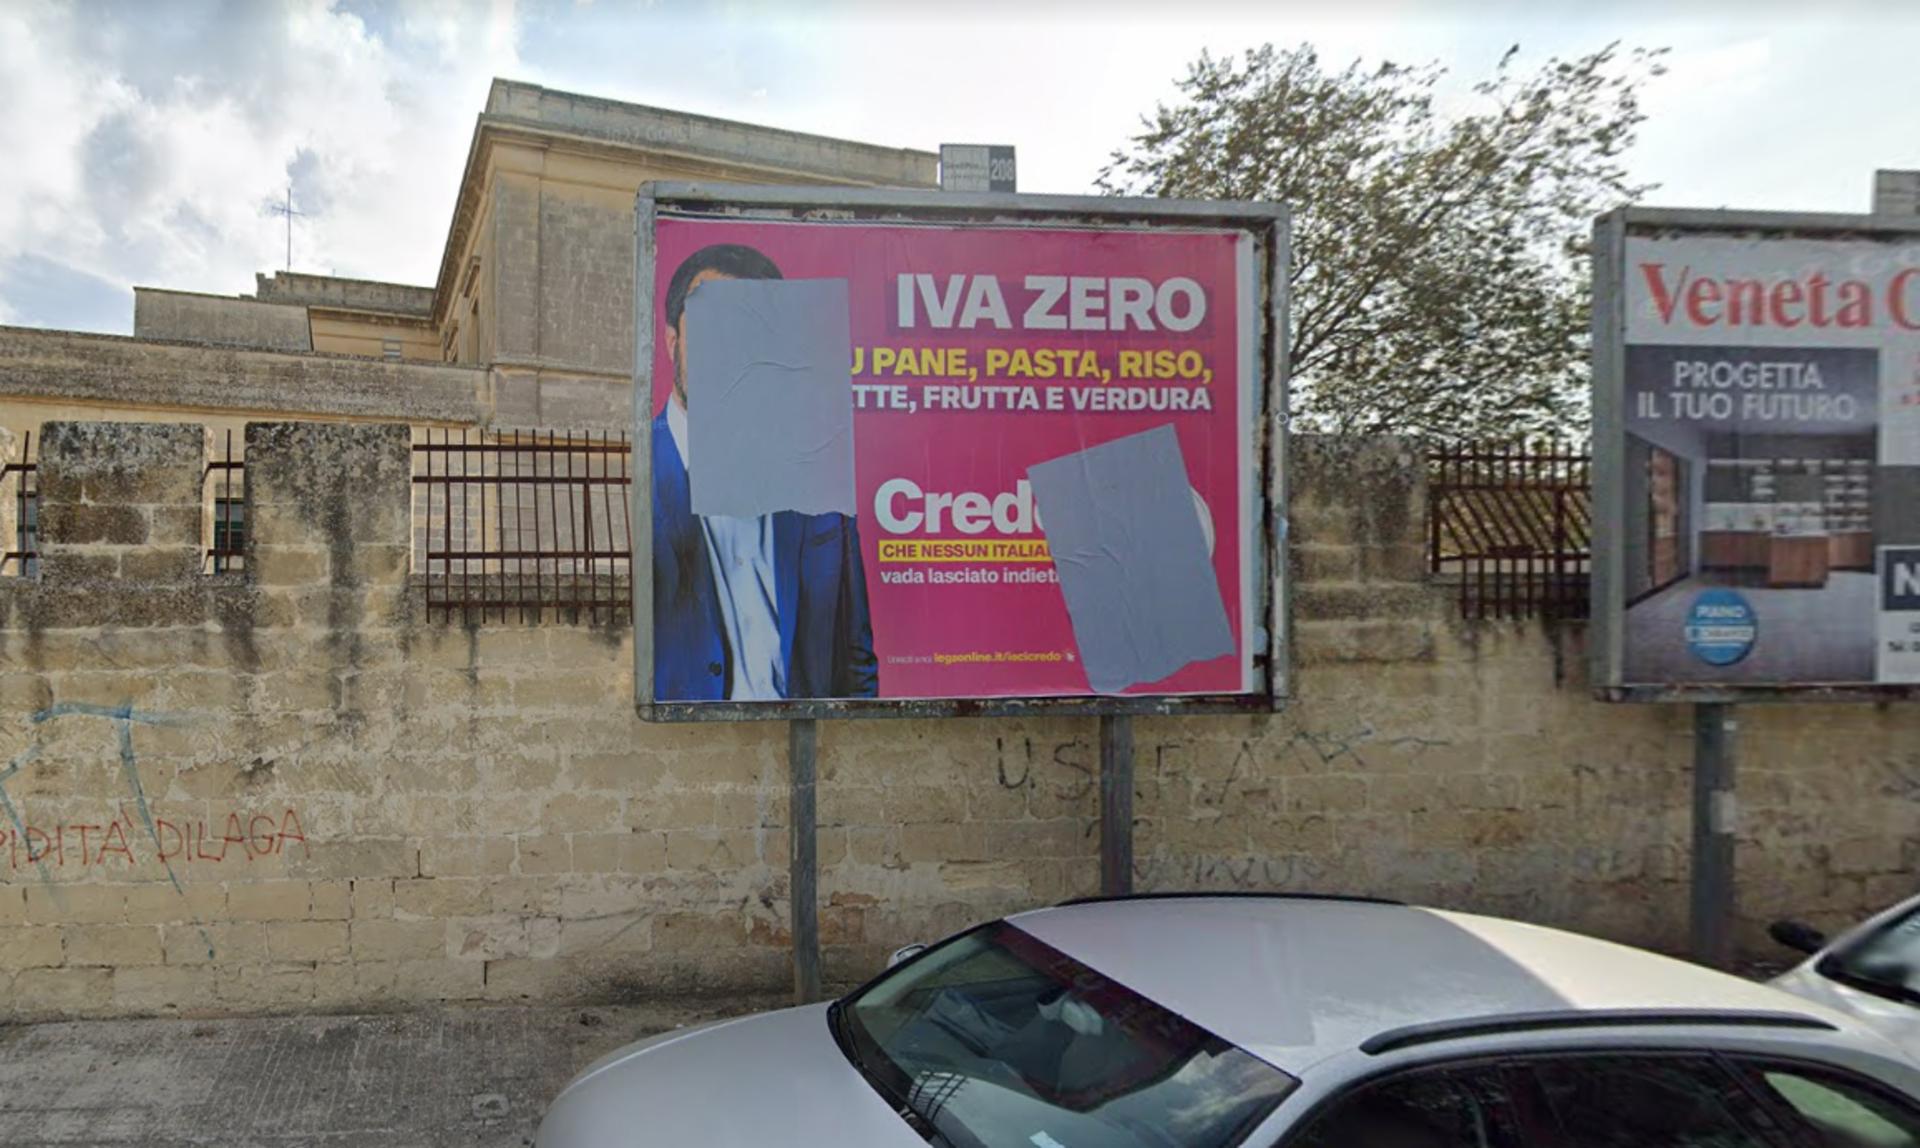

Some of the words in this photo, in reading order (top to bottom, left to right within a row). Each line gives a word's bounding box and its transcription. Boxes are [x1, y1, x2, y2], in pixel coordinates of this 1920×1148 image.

[897, 273, 1013, 329] IVA
[1023, 276, 1207, 332] ZERO
[1639, 263, 1874, 329] Veneta
[872, 347, 978, 382] PANE,
[987, 349, 1111, 383] PASTA,
[1119, 350, 1213, 384] RISO,
[1674, 362, 1824, 389] PROGETTA
[852, 384, 918, 414] TTE,
[924, 385, 1040, 410] FRUTTA
[1046, 387, 1064, 410] E
[1069, 387, 1212, 411] VERDURA
[1638, 393, 1661, 418] IL
[1669, 393, 1733, 420] TUO
[1742, 394, 1857, 421] FUTURO
[874, 478, 1045, 534] Cred
[882, 544, 917, 558] CHE
[921, 544, 988, 557] NESSUN
[992, 544, 1050, 557] ITALIA
[880, 568, 925, 584] vada
[928, 567, 999, 584] lasciato
[156, 809, 311, 862] DILAGA
